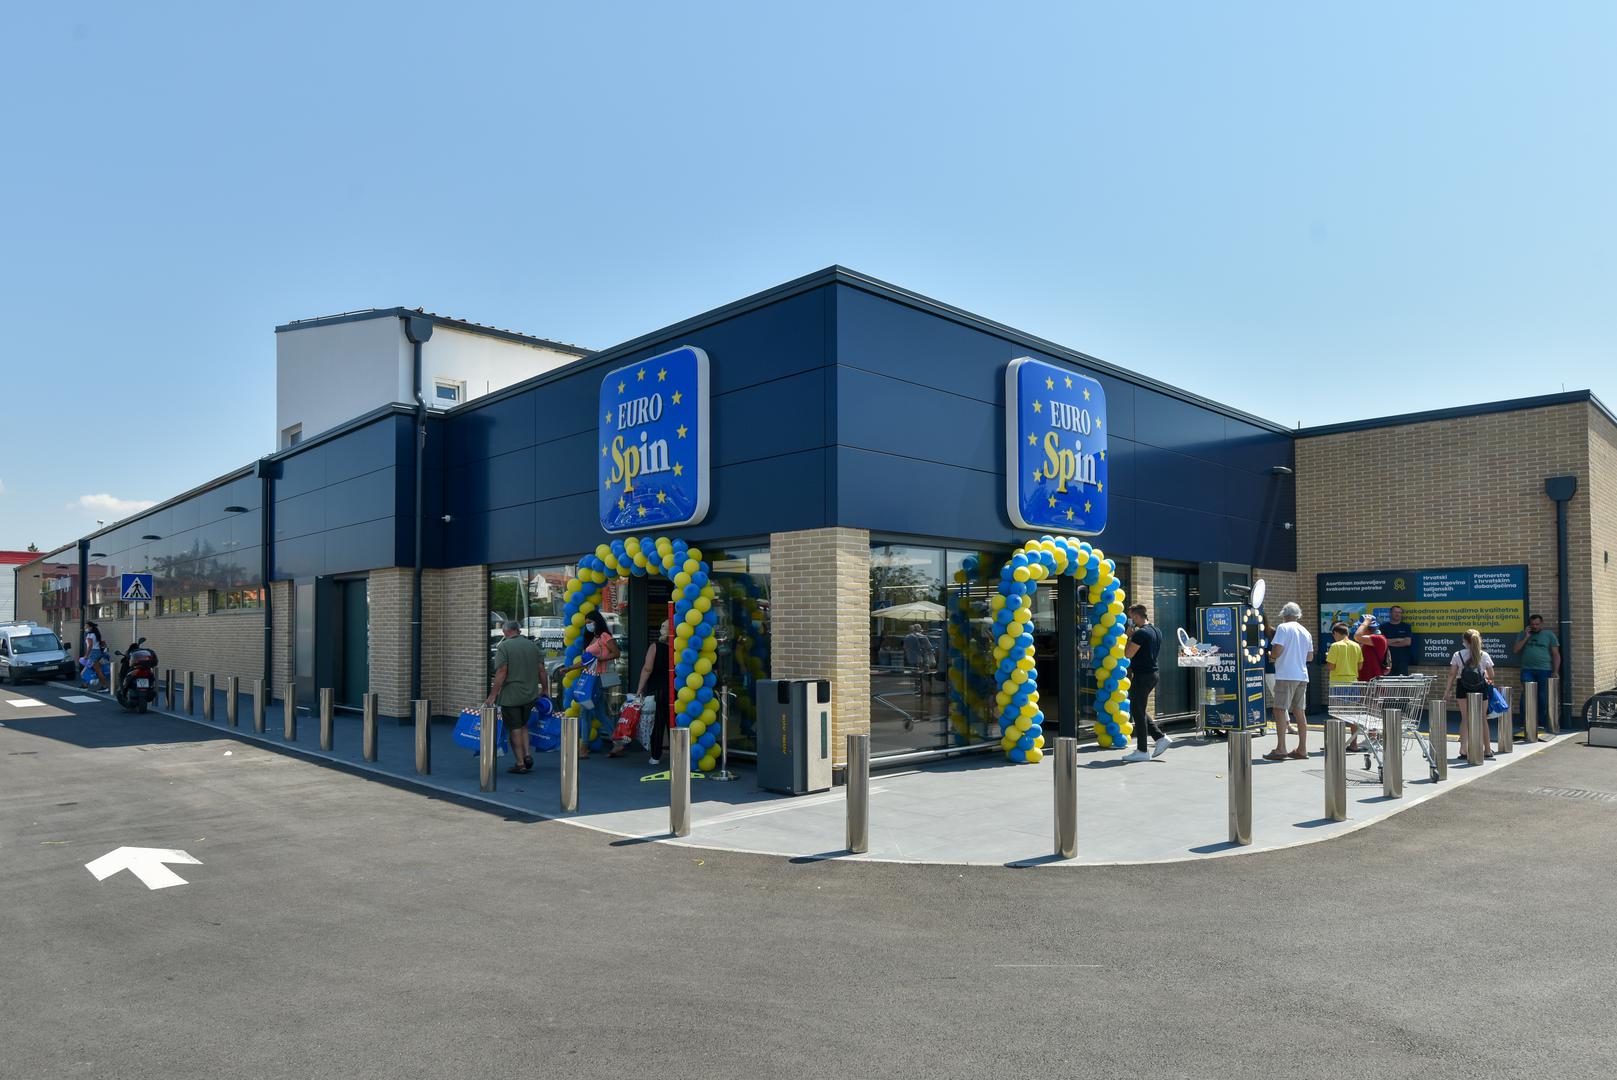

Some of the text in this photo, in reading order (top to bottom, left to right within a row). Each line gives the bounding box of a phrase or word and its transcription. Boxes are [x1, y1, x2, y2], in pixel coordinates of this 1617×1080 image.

[617, 392, 663, 431] EURO
[1050, 400, 1092, 435] EURO
[611, 430, 671, 493] Spin
[1043, 431, 1097, 493] Spin
[1212, 673, 1231, 681] 13.8.
